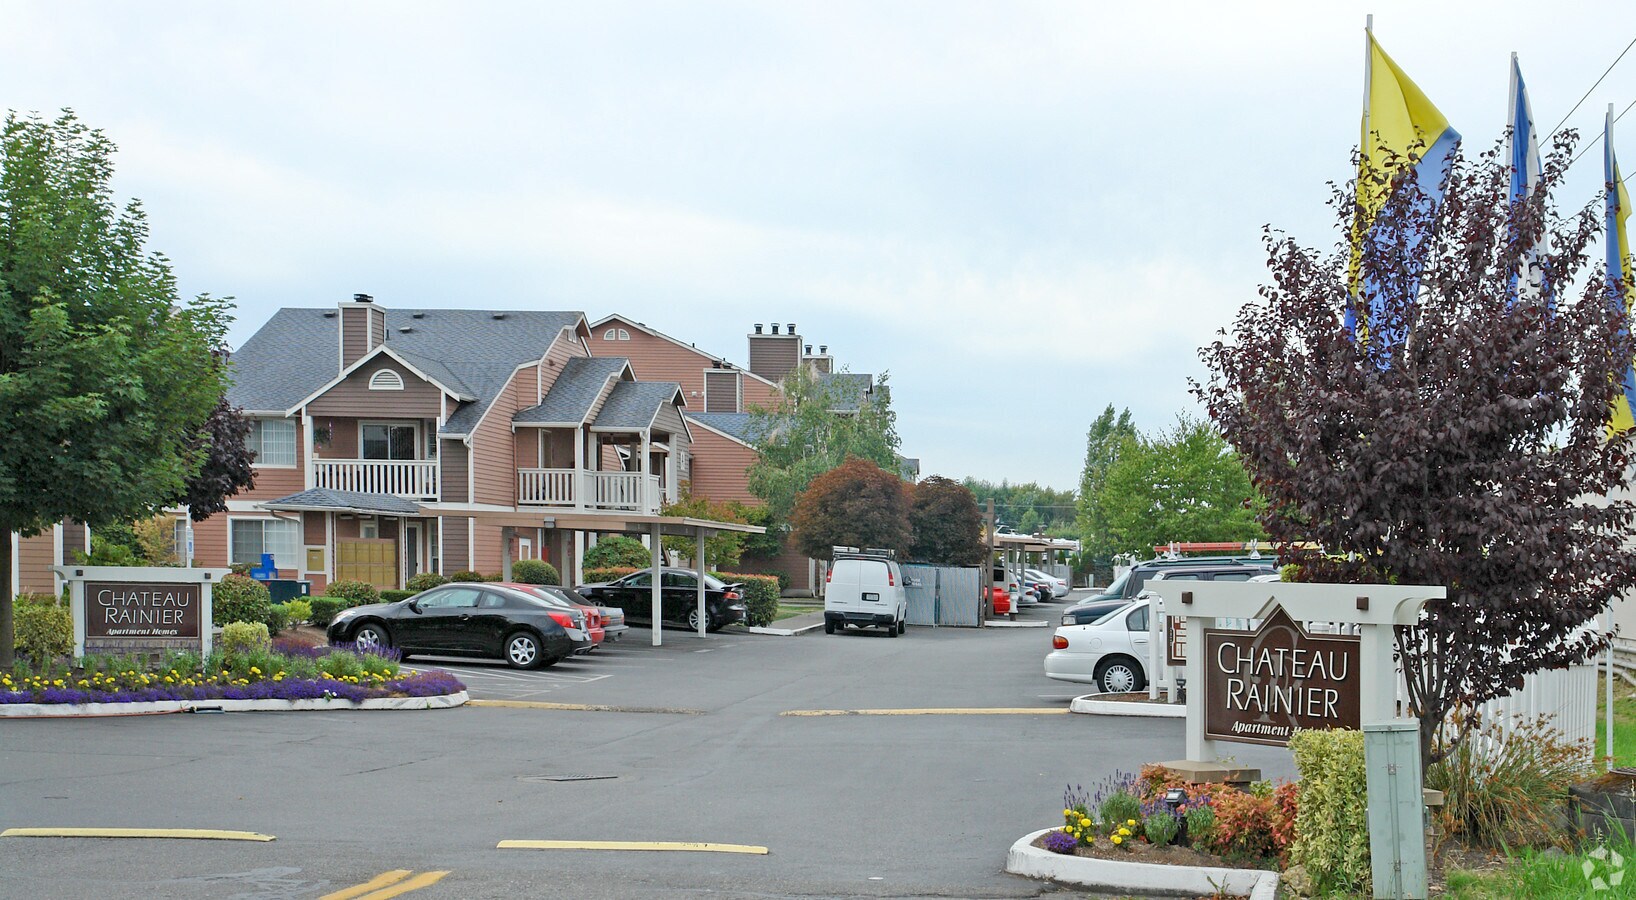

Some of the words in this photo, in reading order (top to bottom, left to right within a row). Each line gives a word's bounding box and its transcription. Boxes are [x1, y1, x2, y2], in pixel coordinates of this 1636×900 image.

[97, 589, 190, 607] CHATEAU
[104, 607, 184, 624] RAINIER
[106, 628, 150, 636] Apartment
[1217, 642, 1348, 681] CHATEAU
[1226, 678, 1339, 718] RAINIER
[1231, 720, 1290, 736] Apartment
